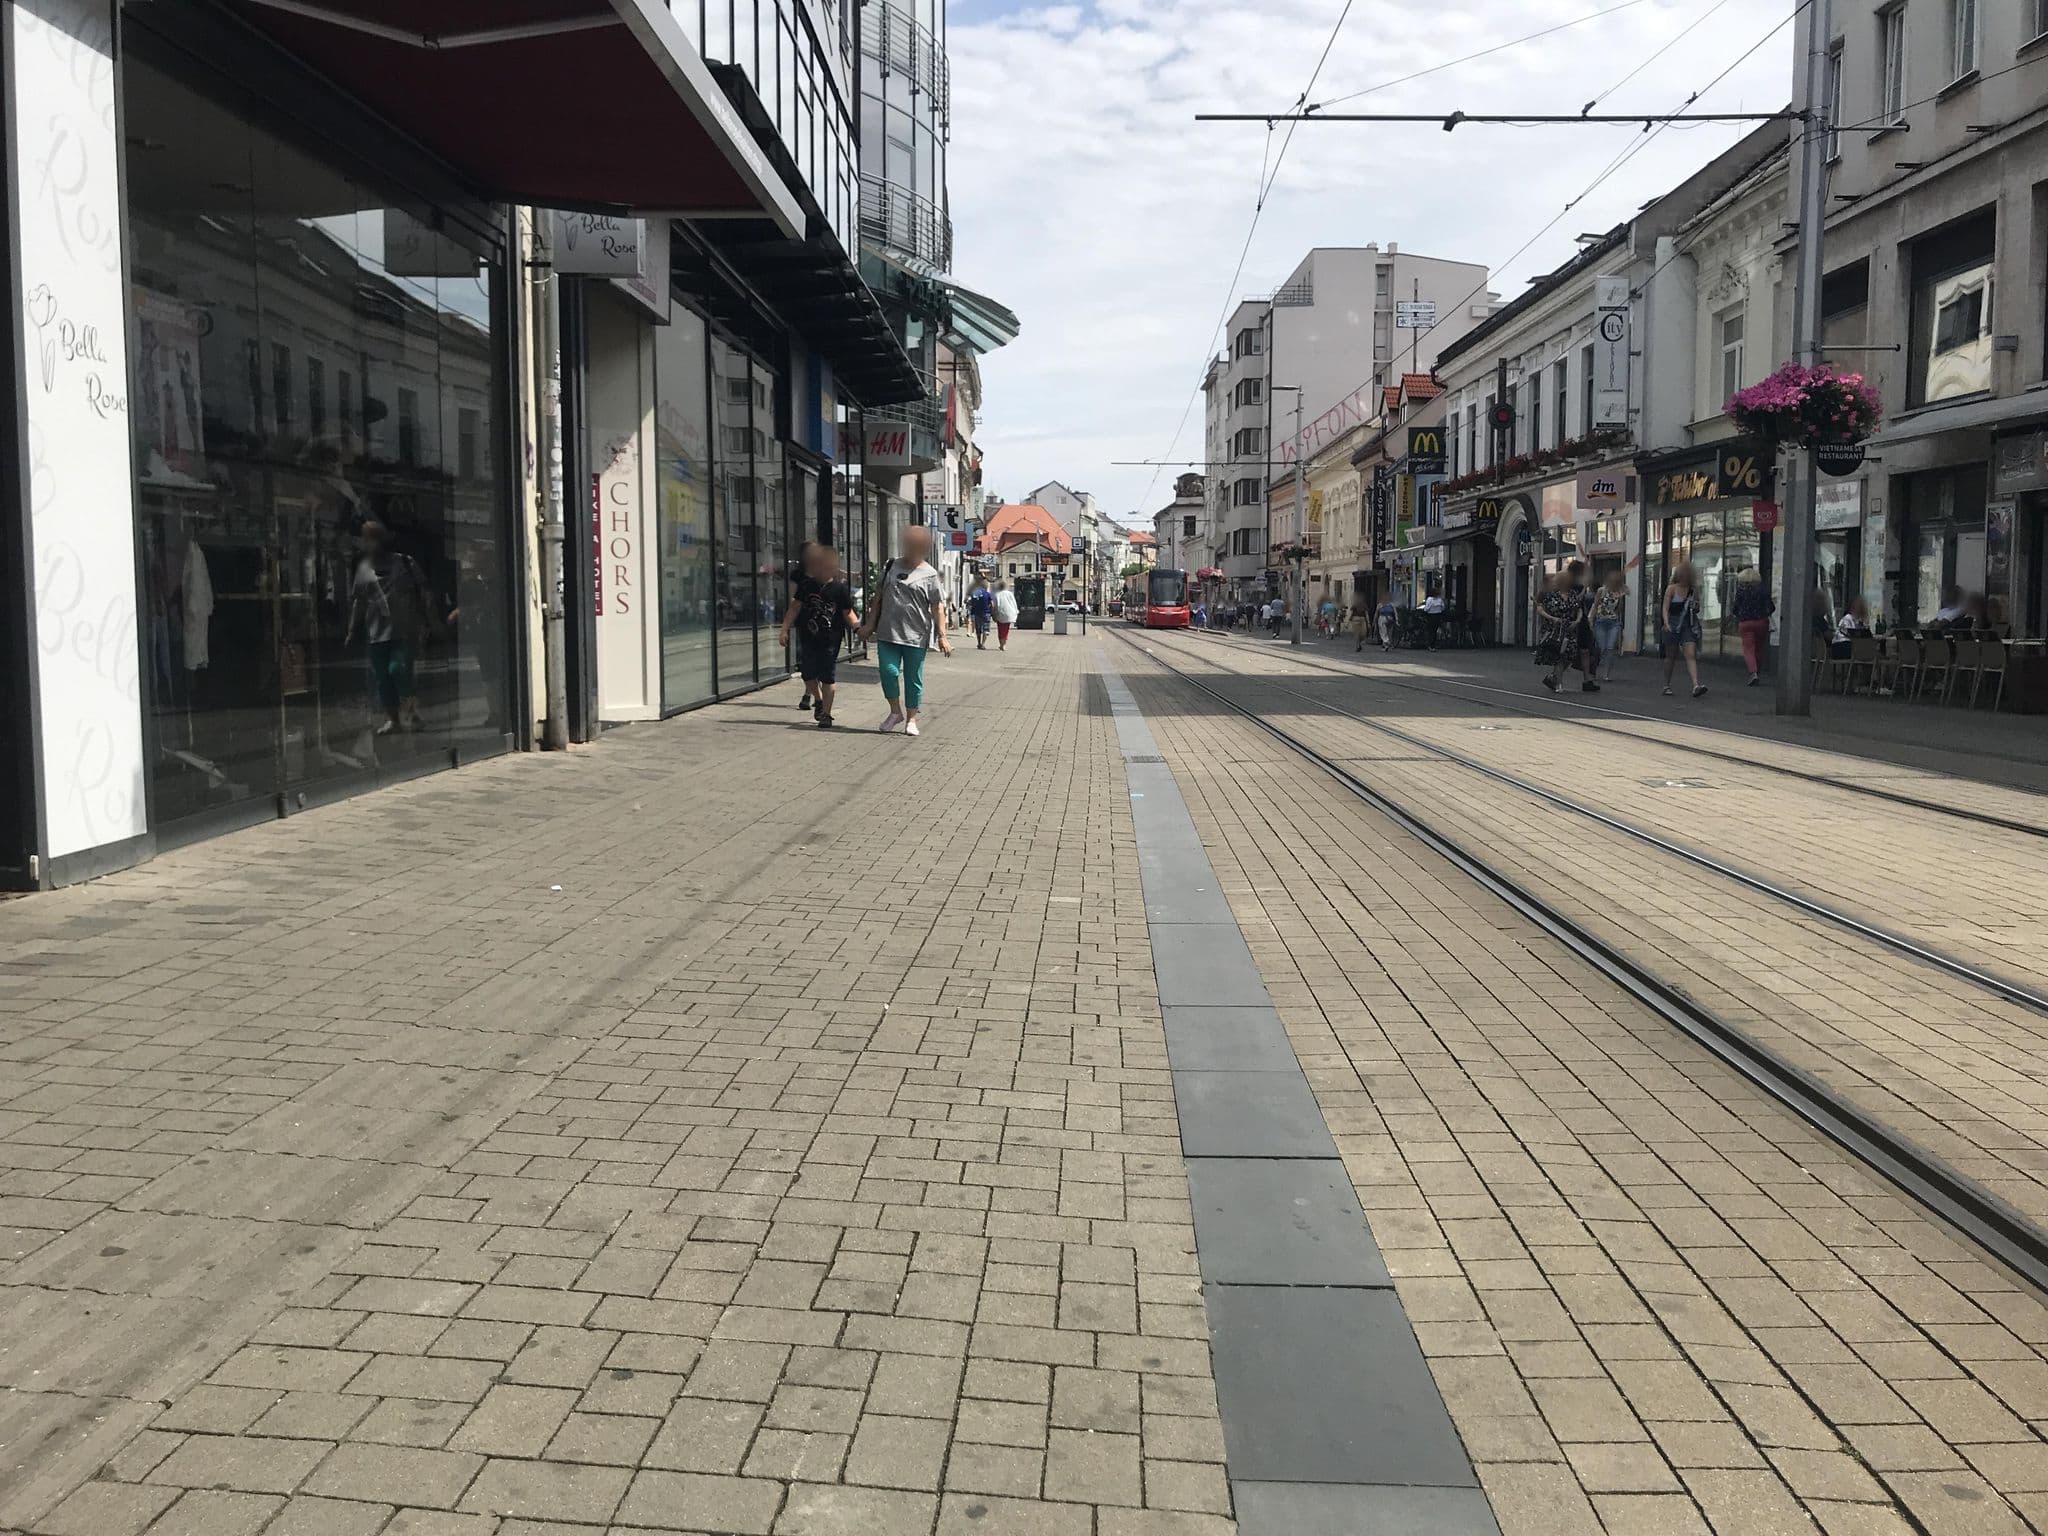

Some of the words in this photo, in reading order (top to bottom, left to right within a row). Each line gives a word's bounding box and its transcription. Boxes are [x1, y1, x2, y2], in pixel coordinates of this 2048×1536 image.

[581, 213, 620, 234] Bella
[601, 236, 637, 259] Rose
[59, 317, 107, 362] Bella
[86, 372, 127, 420] Rose
[1819, 452, 1863, 460] RESTAURANT
[1820, 444, 1863, 452] VIETNAMESE
[1592, 479, 1615, 492] dm
[610, 481, 632, 615] CHORS
